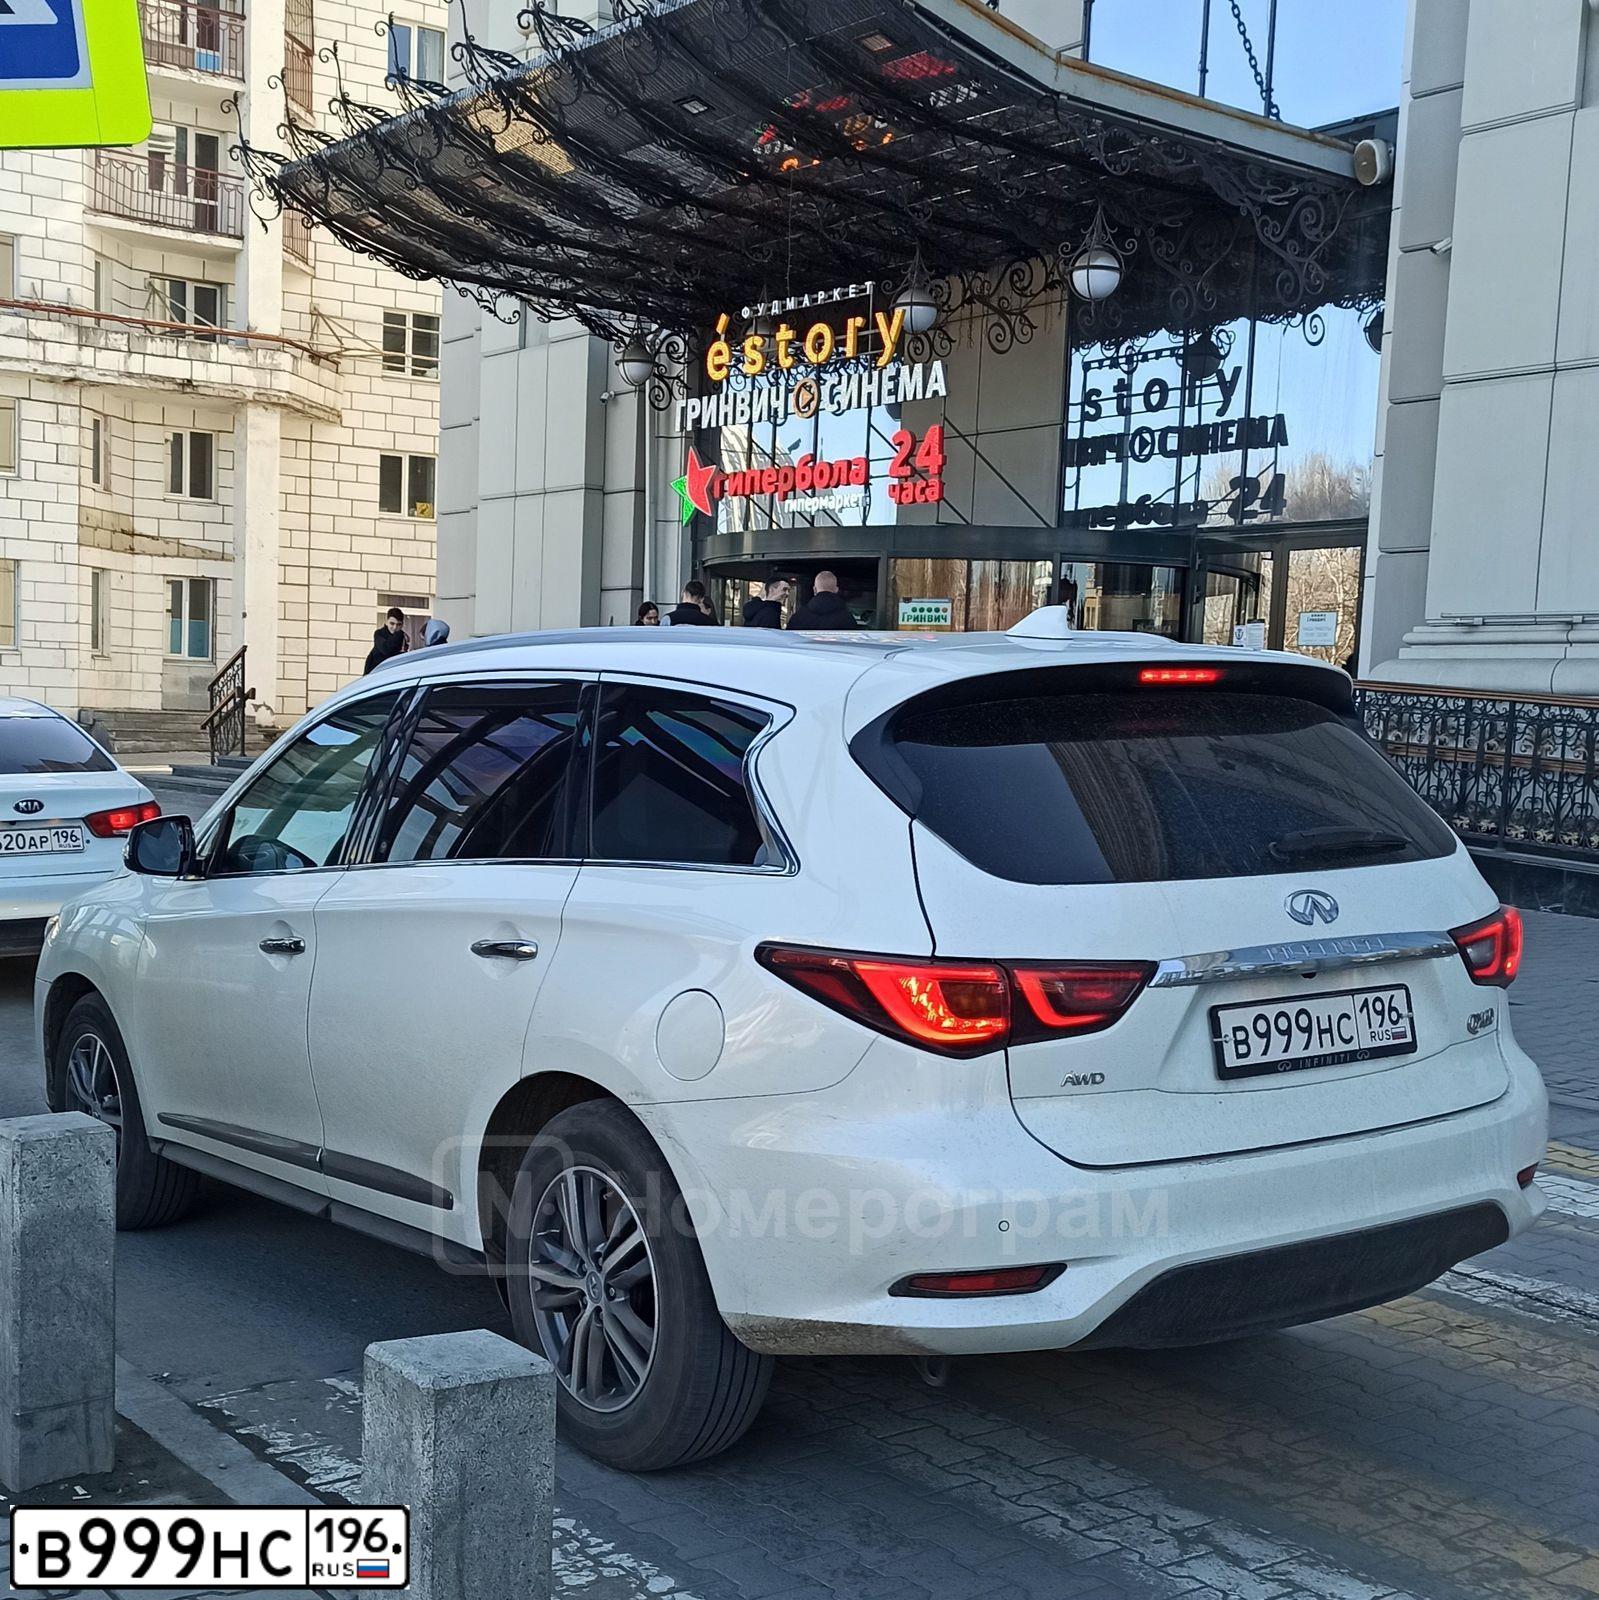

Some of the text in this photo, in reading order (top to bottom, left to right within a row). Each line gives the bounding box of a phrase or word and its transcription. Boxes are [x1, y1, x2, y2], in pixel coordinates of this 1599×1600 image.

[741, 281, 874, 319] ФУДМАРКЕТ
[675, 360, 948, 432] ГРИНВИЧ СИНЕМА
[888, 424, 948, 478] 24
[712, 453, 870, 501] гипербола
[784, 492, 867, 516] гипермаркет
[888, 478, 945, 505] часа
[18, 801, 41, 812] KIA
[0, 829, 79, 851] 20АР 196
[1233, 993, 1401, 1061] В999НС 196
[1369, 1029, 1392, 1043] RUS
[1300, 1053, 1351, 1068] INFINITI
[1060, 1071, 1105, 1088] AWD
